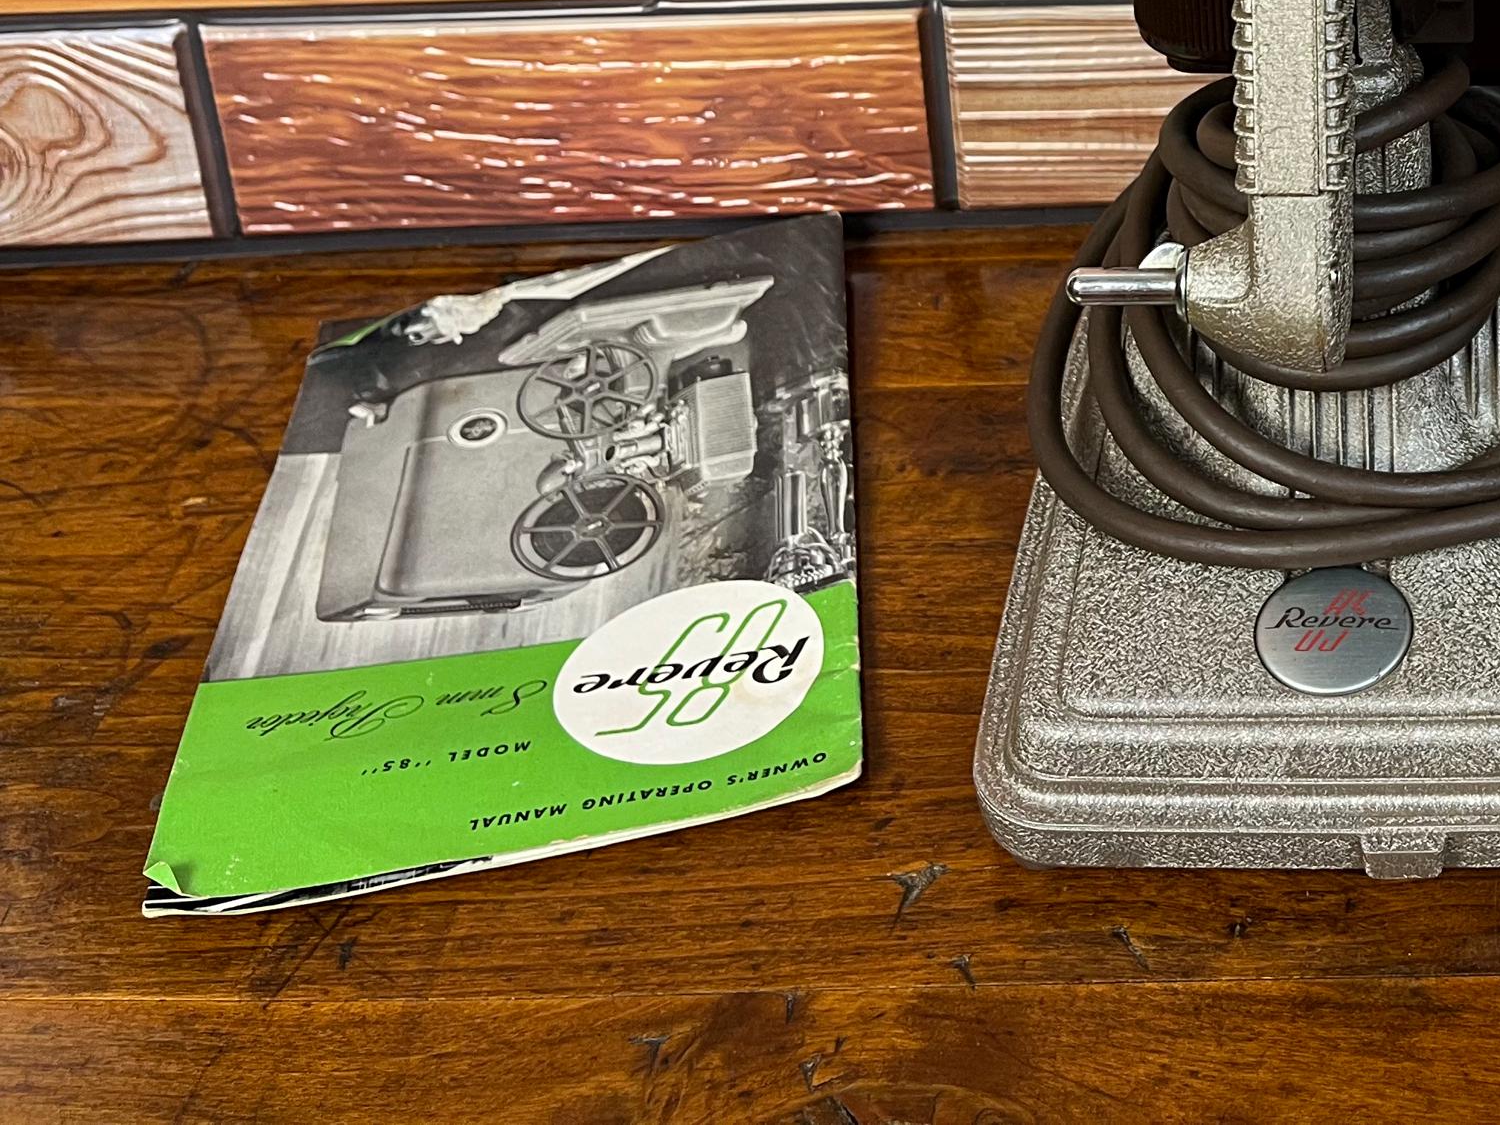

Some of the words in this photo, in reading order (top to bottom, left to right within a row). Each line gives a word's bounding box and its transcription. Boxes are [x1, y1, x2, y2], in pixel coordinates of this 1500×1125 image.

[1265, 607, 1399, 629] Revere
[573, 635, 810, 698] Revere
[594, 599, 786, 737] 85
[245, 689, 424, 739] Projector
[446, 739, 531, 764] MODEL
[725, 751, 827, 786] OWNER'S
[580, 778, 712, 808] OPERATING
[467, 803, 567, 832] MANUAL
